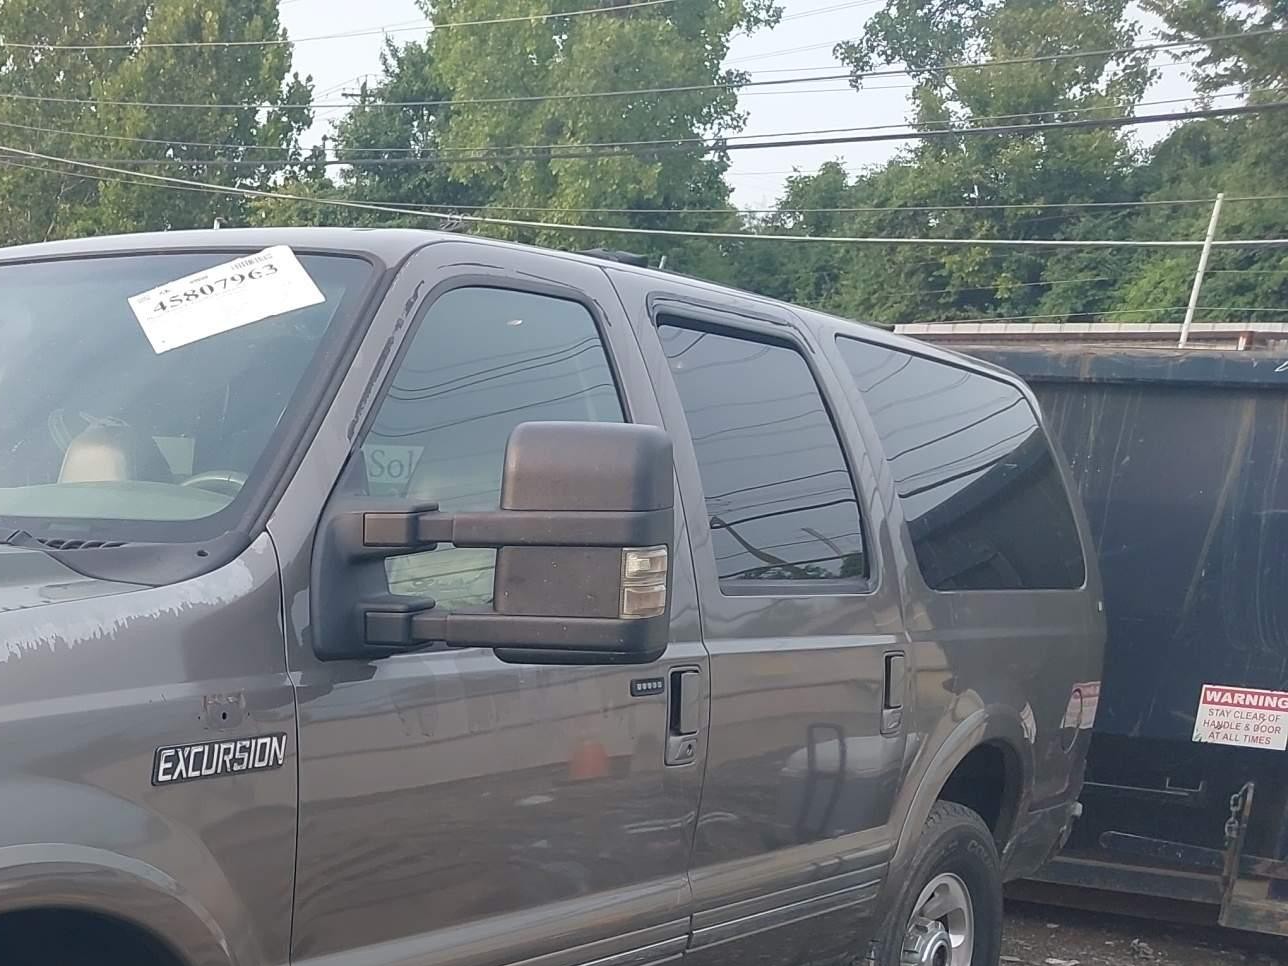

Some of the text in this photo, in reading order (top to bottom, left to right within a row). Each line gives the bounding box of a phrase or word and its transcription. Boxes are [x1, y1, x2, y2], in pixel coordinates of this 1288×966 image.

[153, 264, 278, 312] 45807963
[1206, 690, 1288, 709] WARNING
[1208, 708, 1281, 722] STAY CLEAR OF
[1202, 719, 1281, 734] HANDLE & DOOR
[1208, 731, 1272, 745] AT ALL TIMES
[157, 734, 287, 782] EXCURSION
